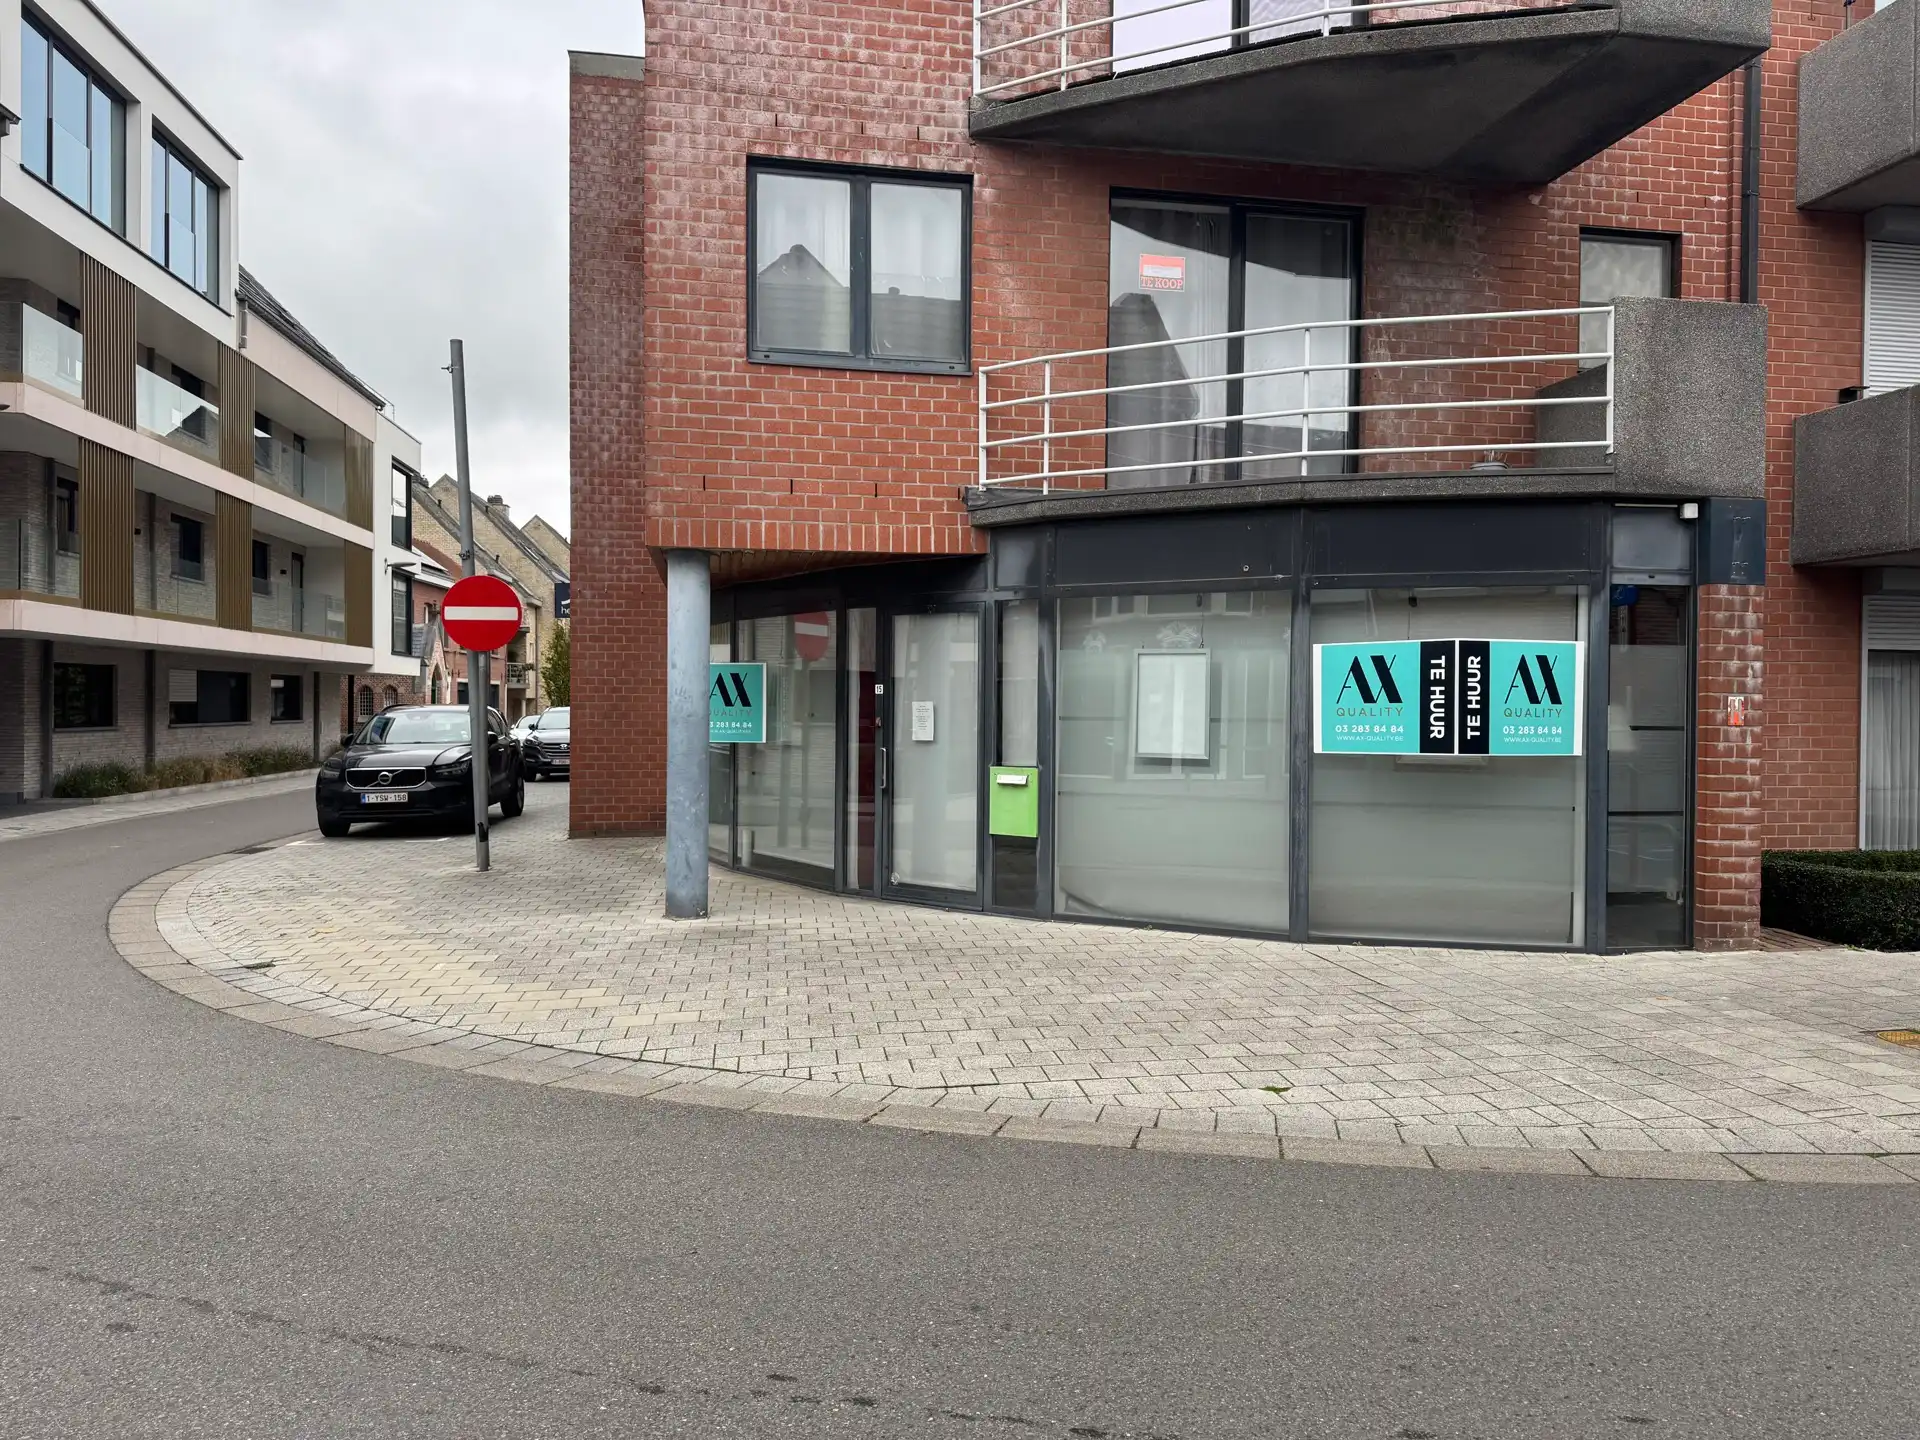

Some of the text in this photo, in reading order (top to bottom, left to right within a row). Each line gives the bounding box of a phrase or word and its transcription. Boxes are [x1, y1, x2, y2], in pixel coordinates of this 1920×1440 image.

[1141, 276, 1183, 289] TE KOOP
[1336, 654, 1403, 704] AX
[1504, 654, 1562, 705] AX
[709, 672, 752, 707] AX
[1429, 655, 1446, 739] TE HUUR
[1467, 655, 1481, 740] TE HUUR
[709, 709, 752, 717] UALITY
[1336, 707, 1403, 717] QUALITY
[1504, 707, 1562, 718] QUALITY
[1335, 725, 1404, 733] 03 283 84 84
[1502, 726, 1515, 734] 03
[1518, 726, 1534, 734] 283
[1537, 726, 1549, 734] 84
